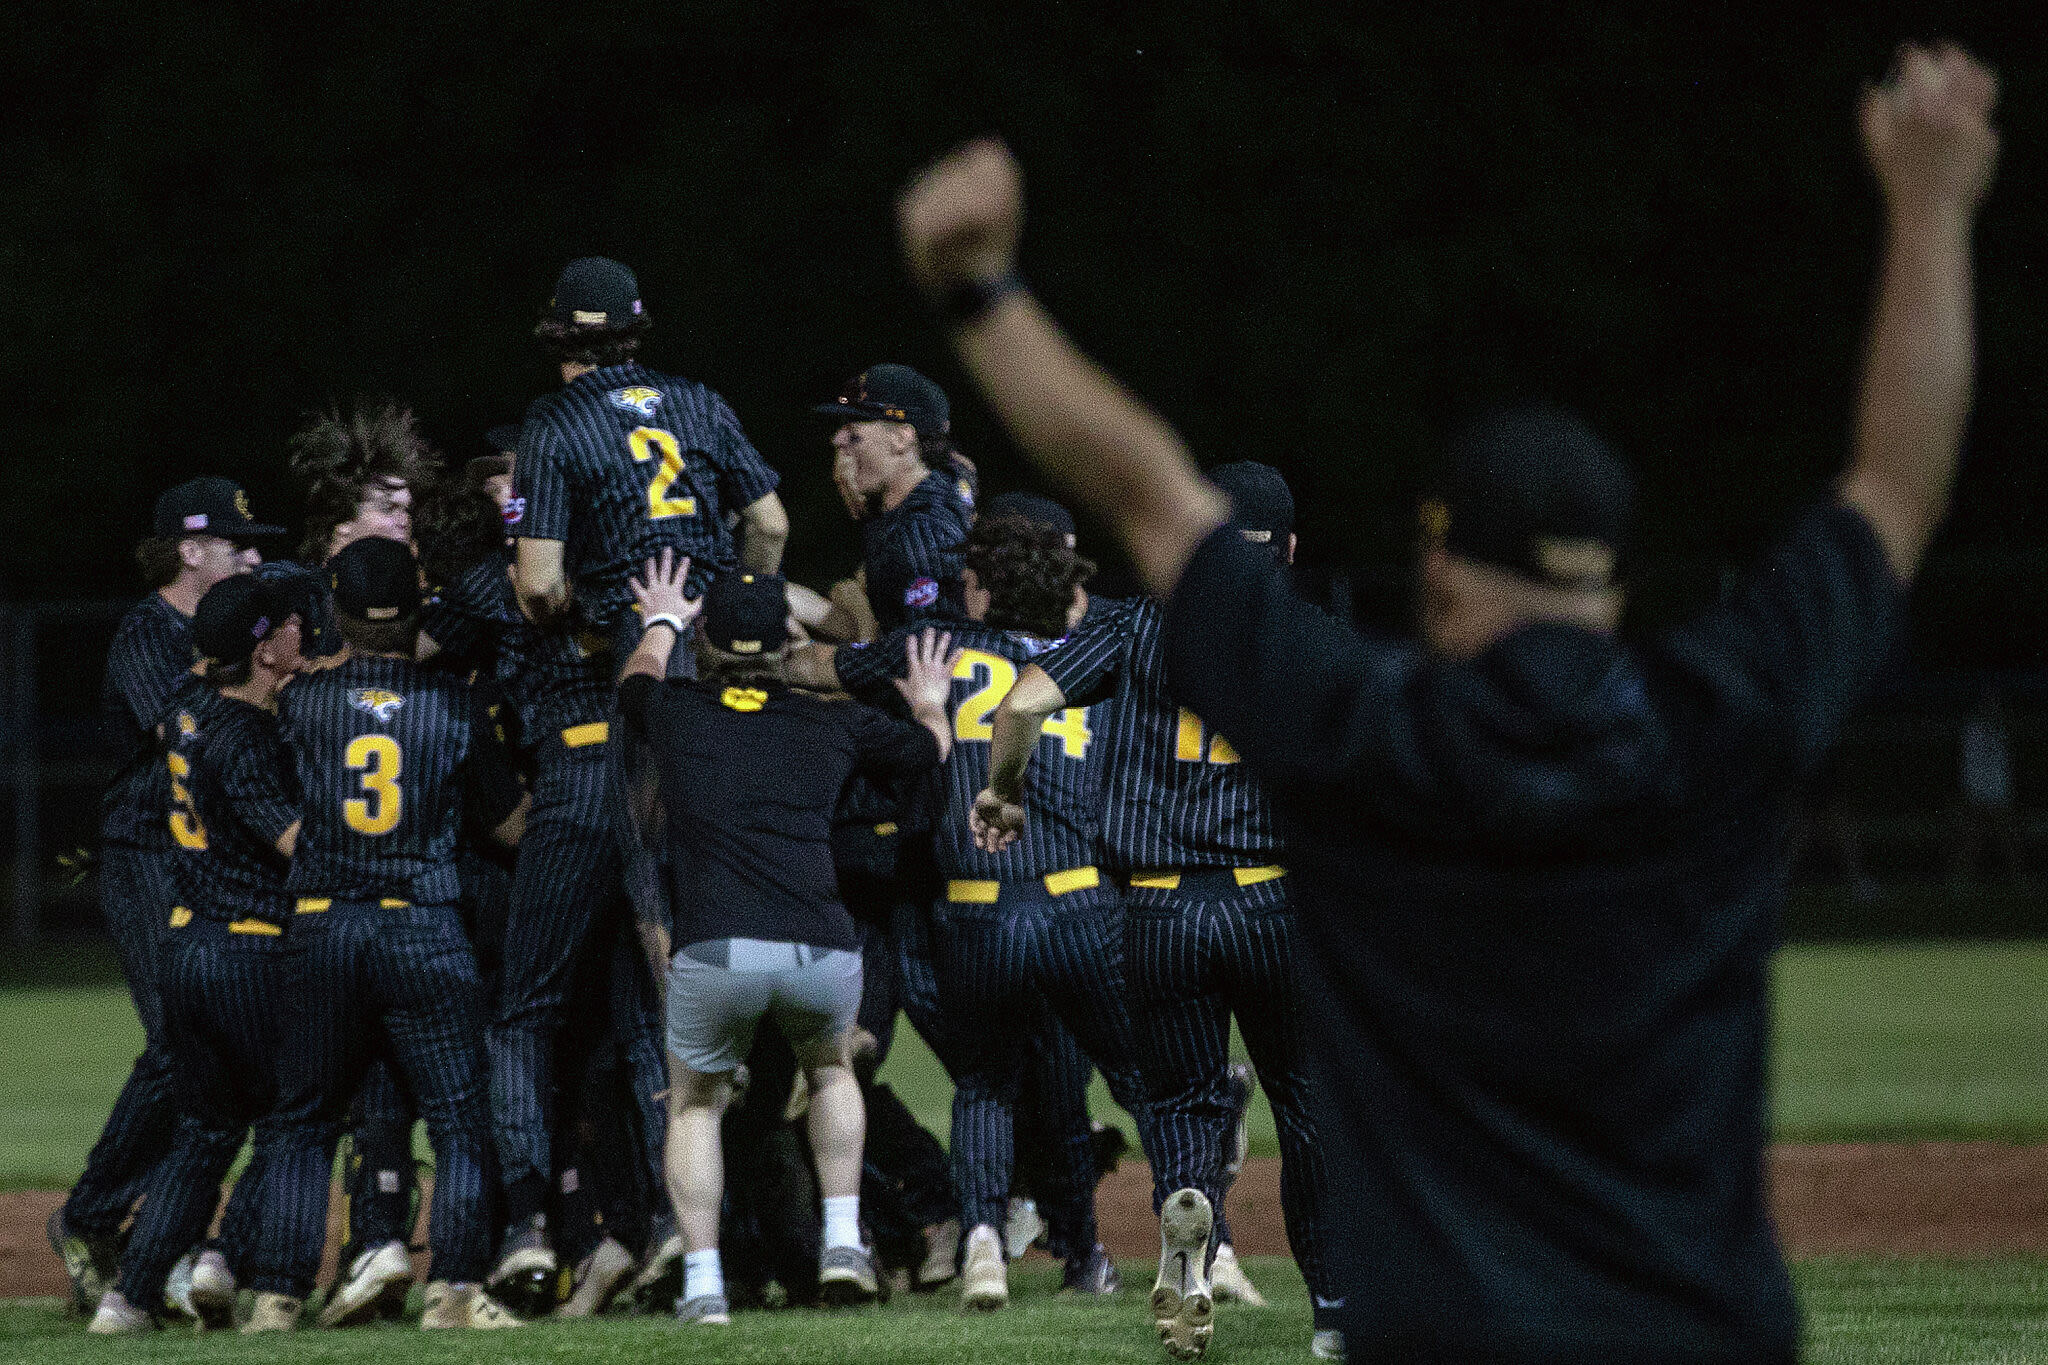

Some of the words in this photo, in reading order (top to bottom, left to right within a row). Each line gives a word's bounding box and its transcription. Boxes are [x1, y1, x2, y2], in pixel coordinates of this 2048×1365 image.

[627, 426, 696, 519] 2
[951, 648, 1092, 758] 24
[342, 733, 403, 835] 3
